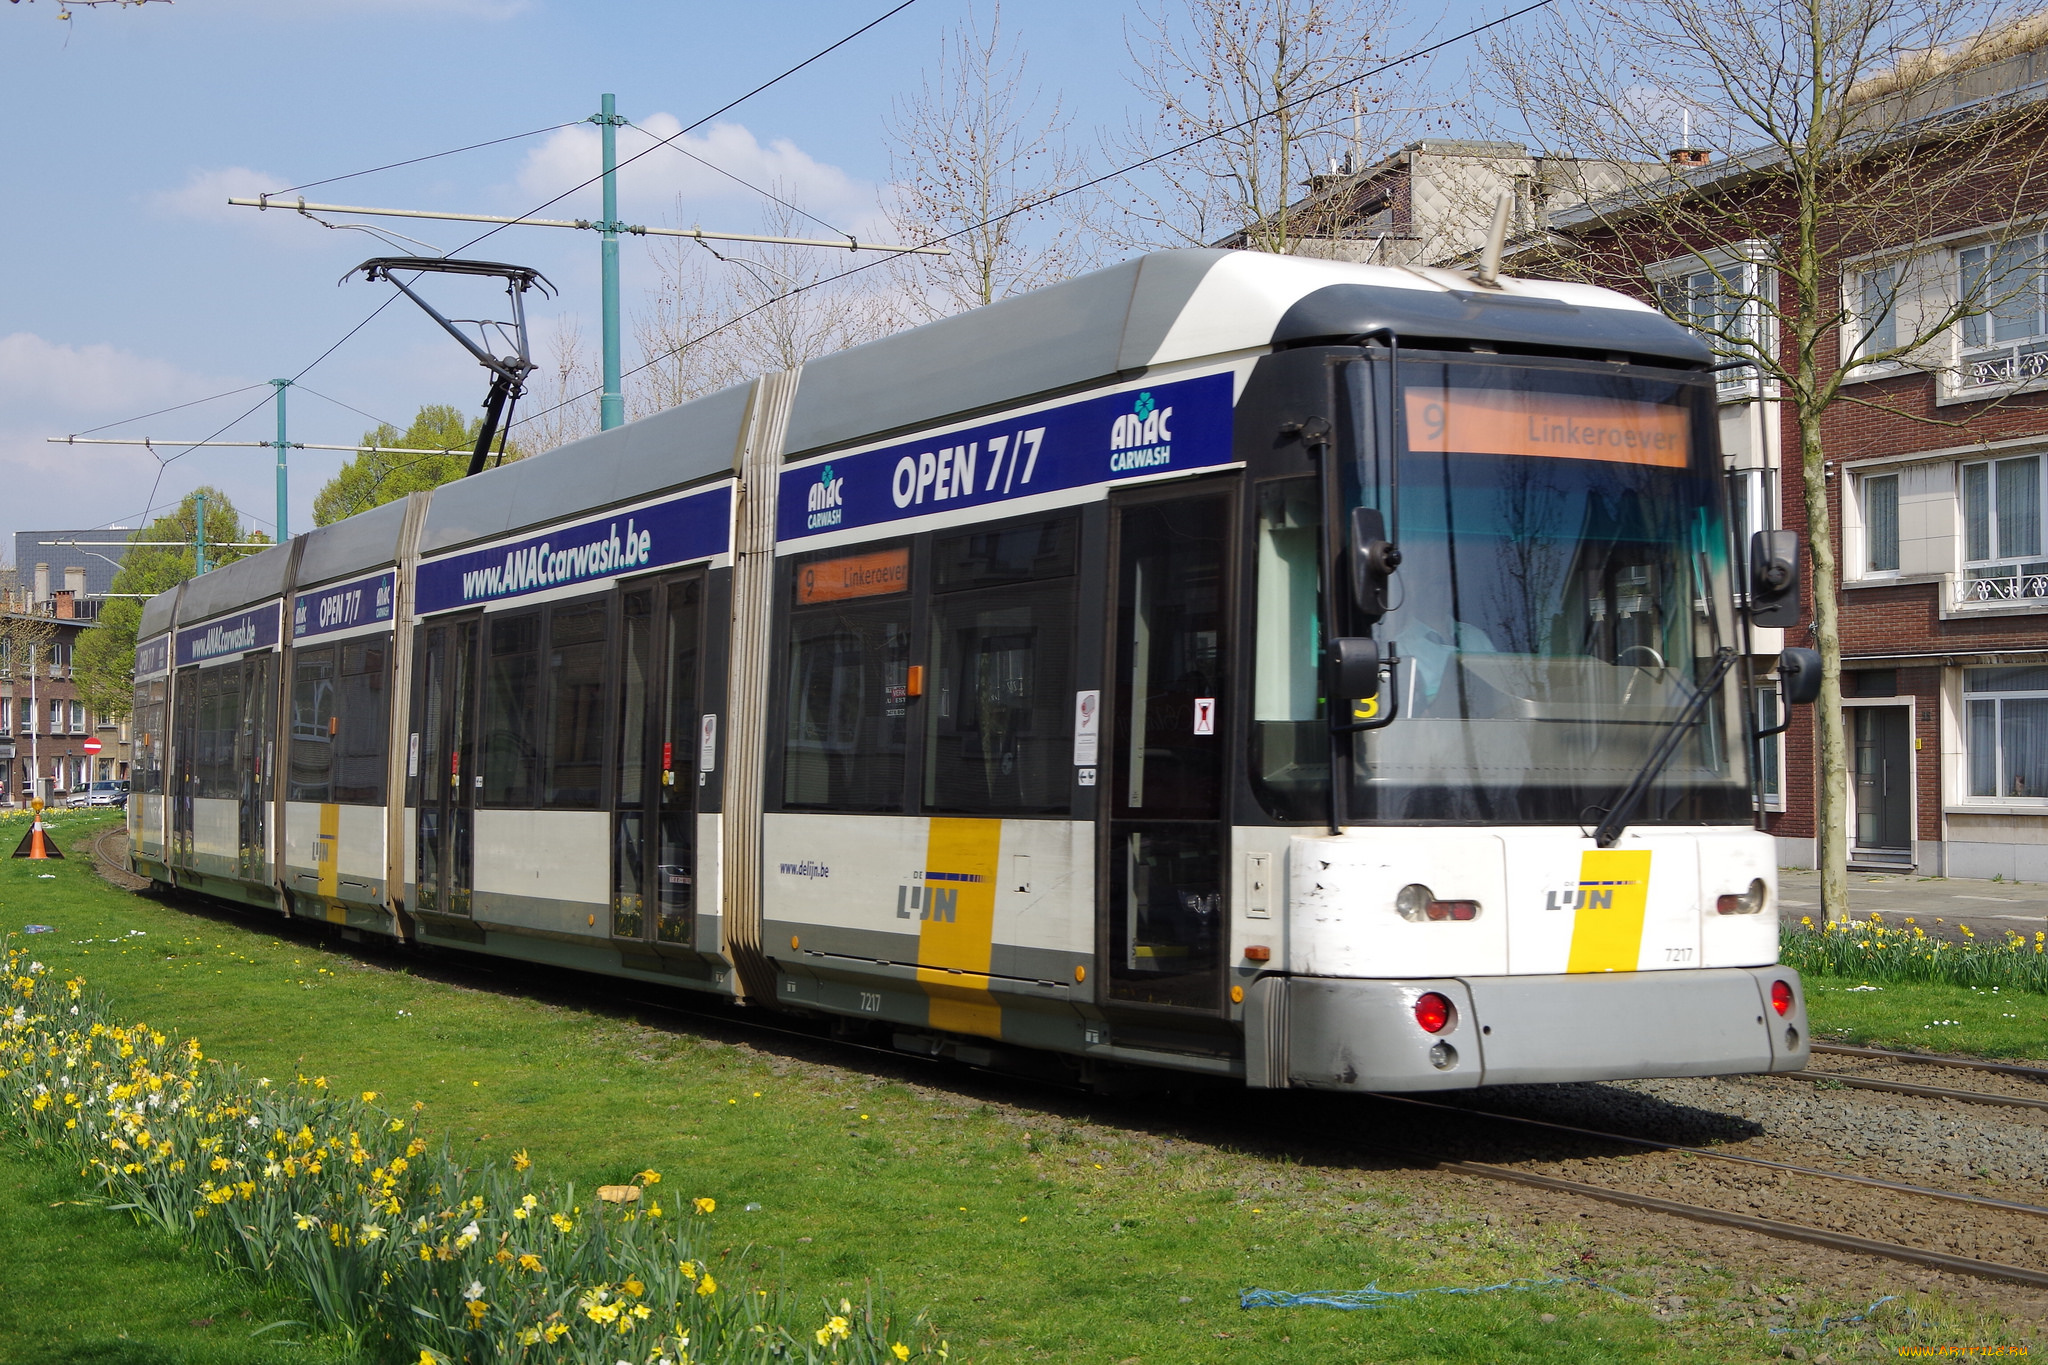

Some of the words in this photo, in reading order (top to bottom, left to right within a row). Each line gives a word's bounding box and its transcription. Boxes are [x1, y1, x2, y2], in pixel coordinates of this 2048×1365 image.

[1422, 403, 1445, 440] 9
[1528, 415, 1677, 451] Linkeroever
[892, 442, 978, 509] OPEN
[985, 426, 1046, 494] 7/7
[1109, 445, 1171, 472] CARWASH
[807, 508, 842, 530] CARWASH
[463, 518, 651, 600] www.ANACcarwash.be
[805, 569, 815, 597] 9
[844, 560, 907, 590] Linkeroever
[319, 593, 343, 628] OPEN
[344, 589, 362, 625] 7/7
[779, 860, 829, 880] www.delijn.be
[913, 870, 923, 880] DE
[896, 885, 958, 923] LIJN
[1545, 889, 1614, 911] LIJN
[1665, 947, 1693, 962] 7217
[860, 992, 881, 1012] 7217
